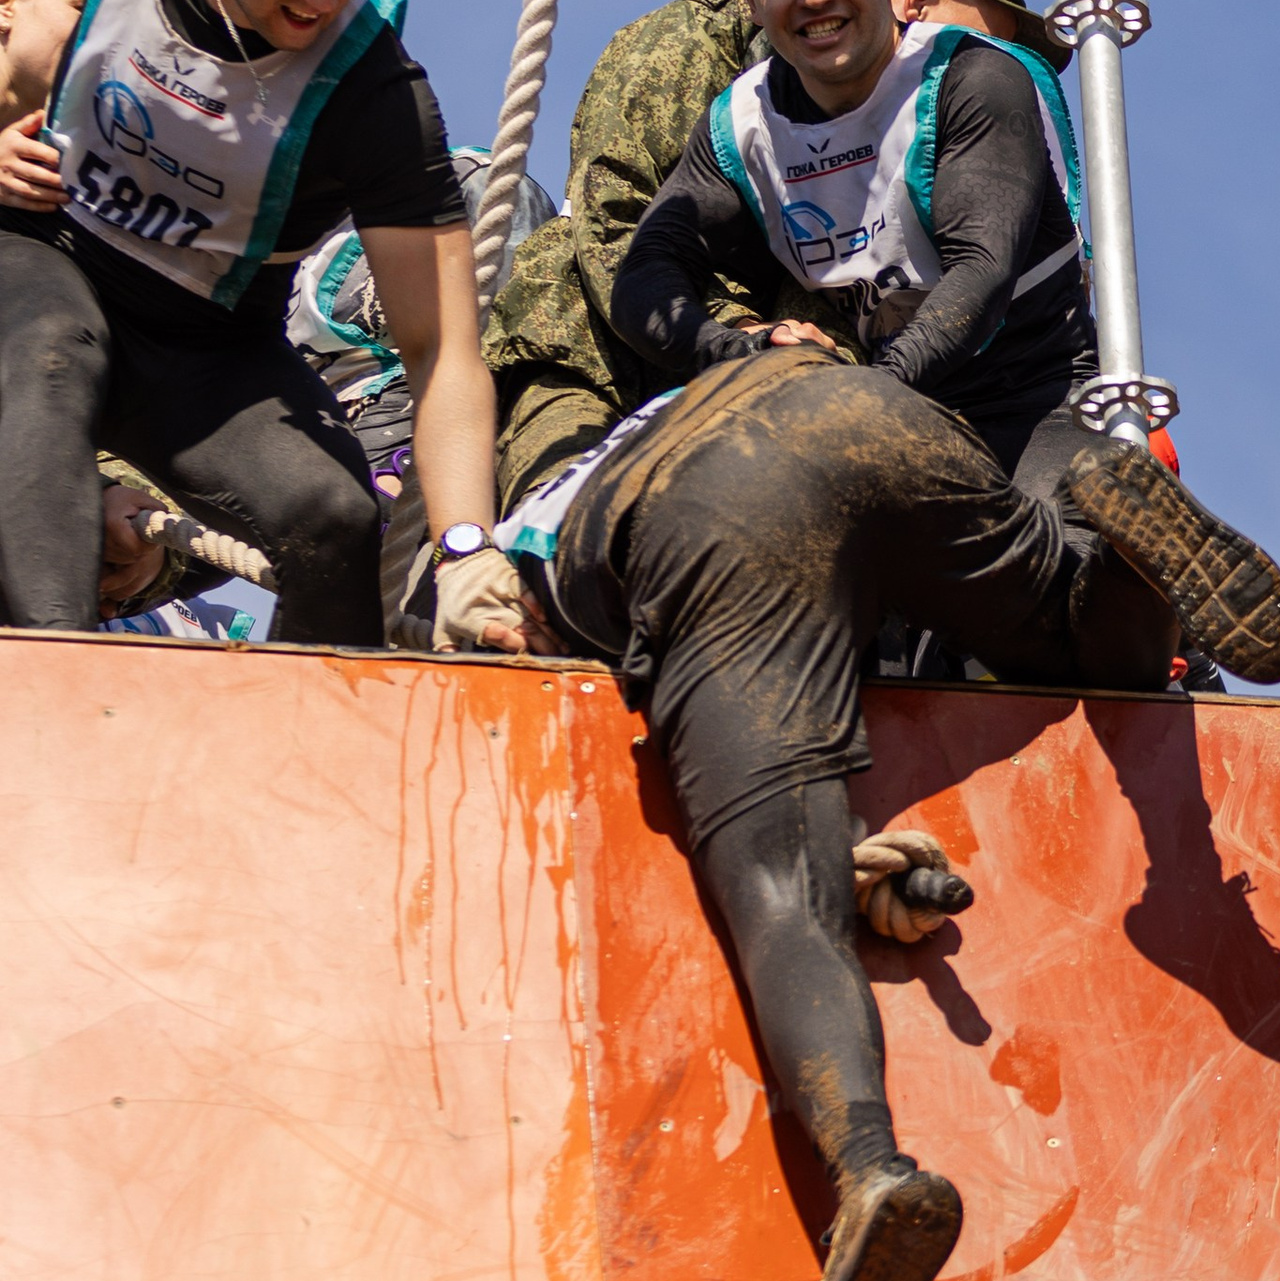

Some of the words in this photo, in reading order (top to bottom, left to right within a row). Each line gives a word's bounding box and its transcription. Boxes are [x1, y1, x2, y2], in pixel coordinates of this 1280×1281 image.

[171, 80, 227, 114] ГЕРОЕВ
[820, 143, 874, 170] ГЕРОЕВ
[67, 150, 214, 248] 5807
